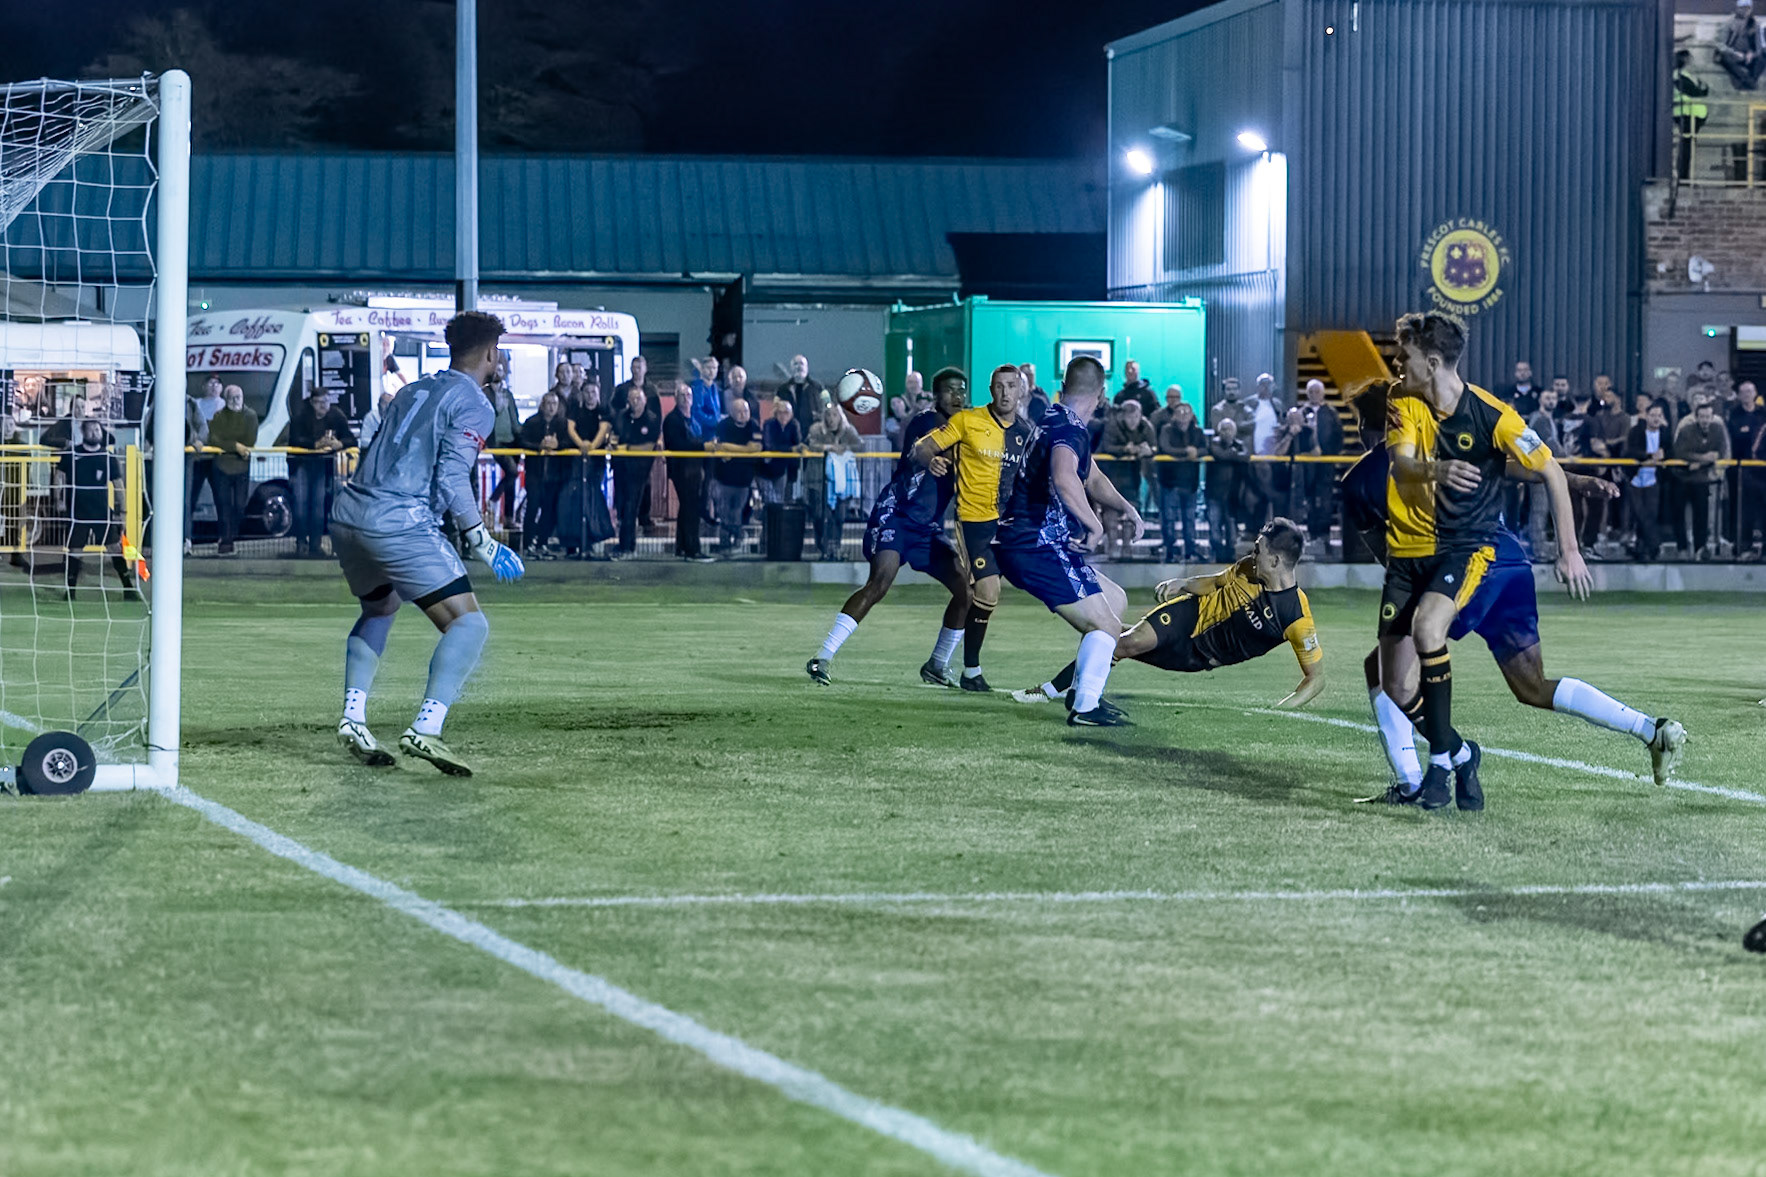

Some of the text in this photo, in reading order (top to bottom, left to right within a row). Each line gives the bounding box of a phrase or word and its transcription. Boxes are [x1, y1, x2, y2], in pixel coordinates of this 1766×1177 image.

[1426, 286, 1479, 315] FOUNDED
[187, 316, 284, 340] Tea Coffee
[331, 311, 353, 326] Tea
[368, 311, 412, 328] Coffee
[509, 313, 539, 330] Dogs
[553, 314, 585, 329] Bacon
[590, 314, 619, 330] Rolls
[209, 347, 274, 368] Snacks
[977, 448, 1021, 464] MERMAI
